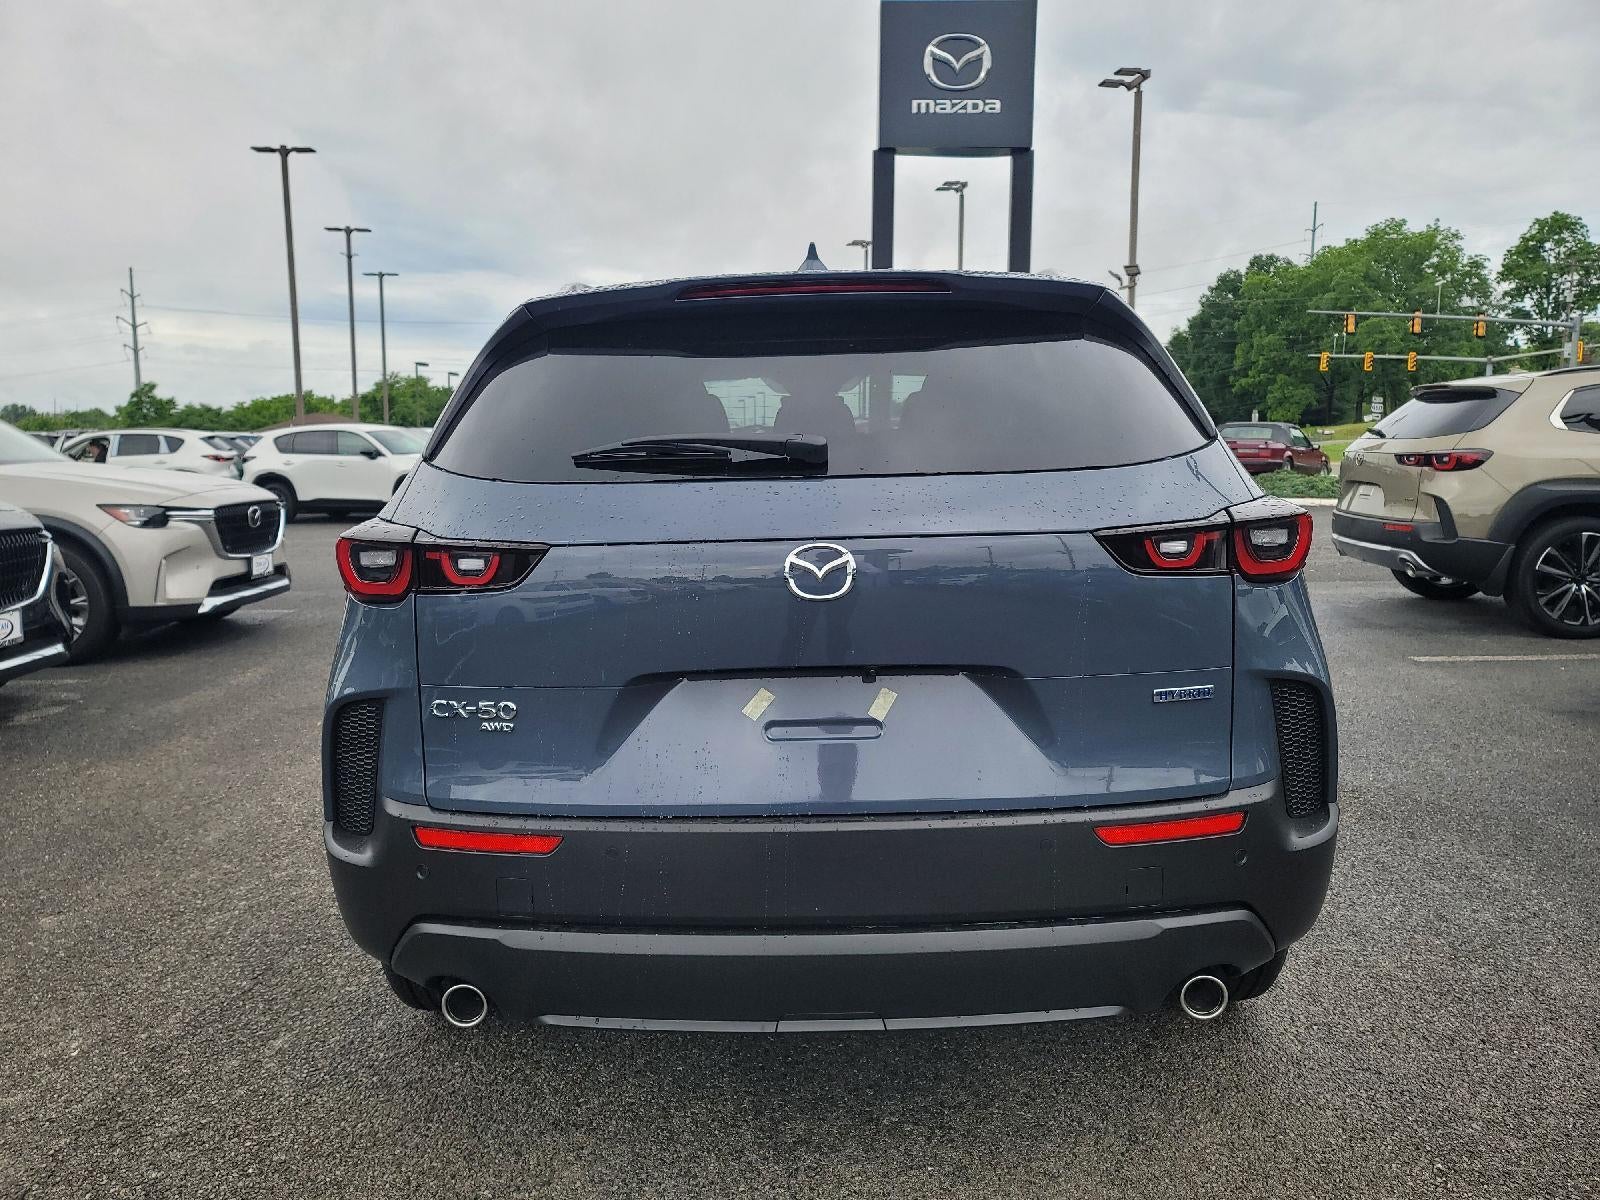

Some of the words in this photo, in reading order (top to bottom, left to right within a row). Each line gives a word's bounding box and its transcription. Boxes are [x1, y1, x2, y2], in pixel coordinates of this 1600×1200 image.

[1158, 686, 1213, 701] HYBRID
[430, 699, 517, 720] CX-50
[480, 721, 515, 733] AWD
